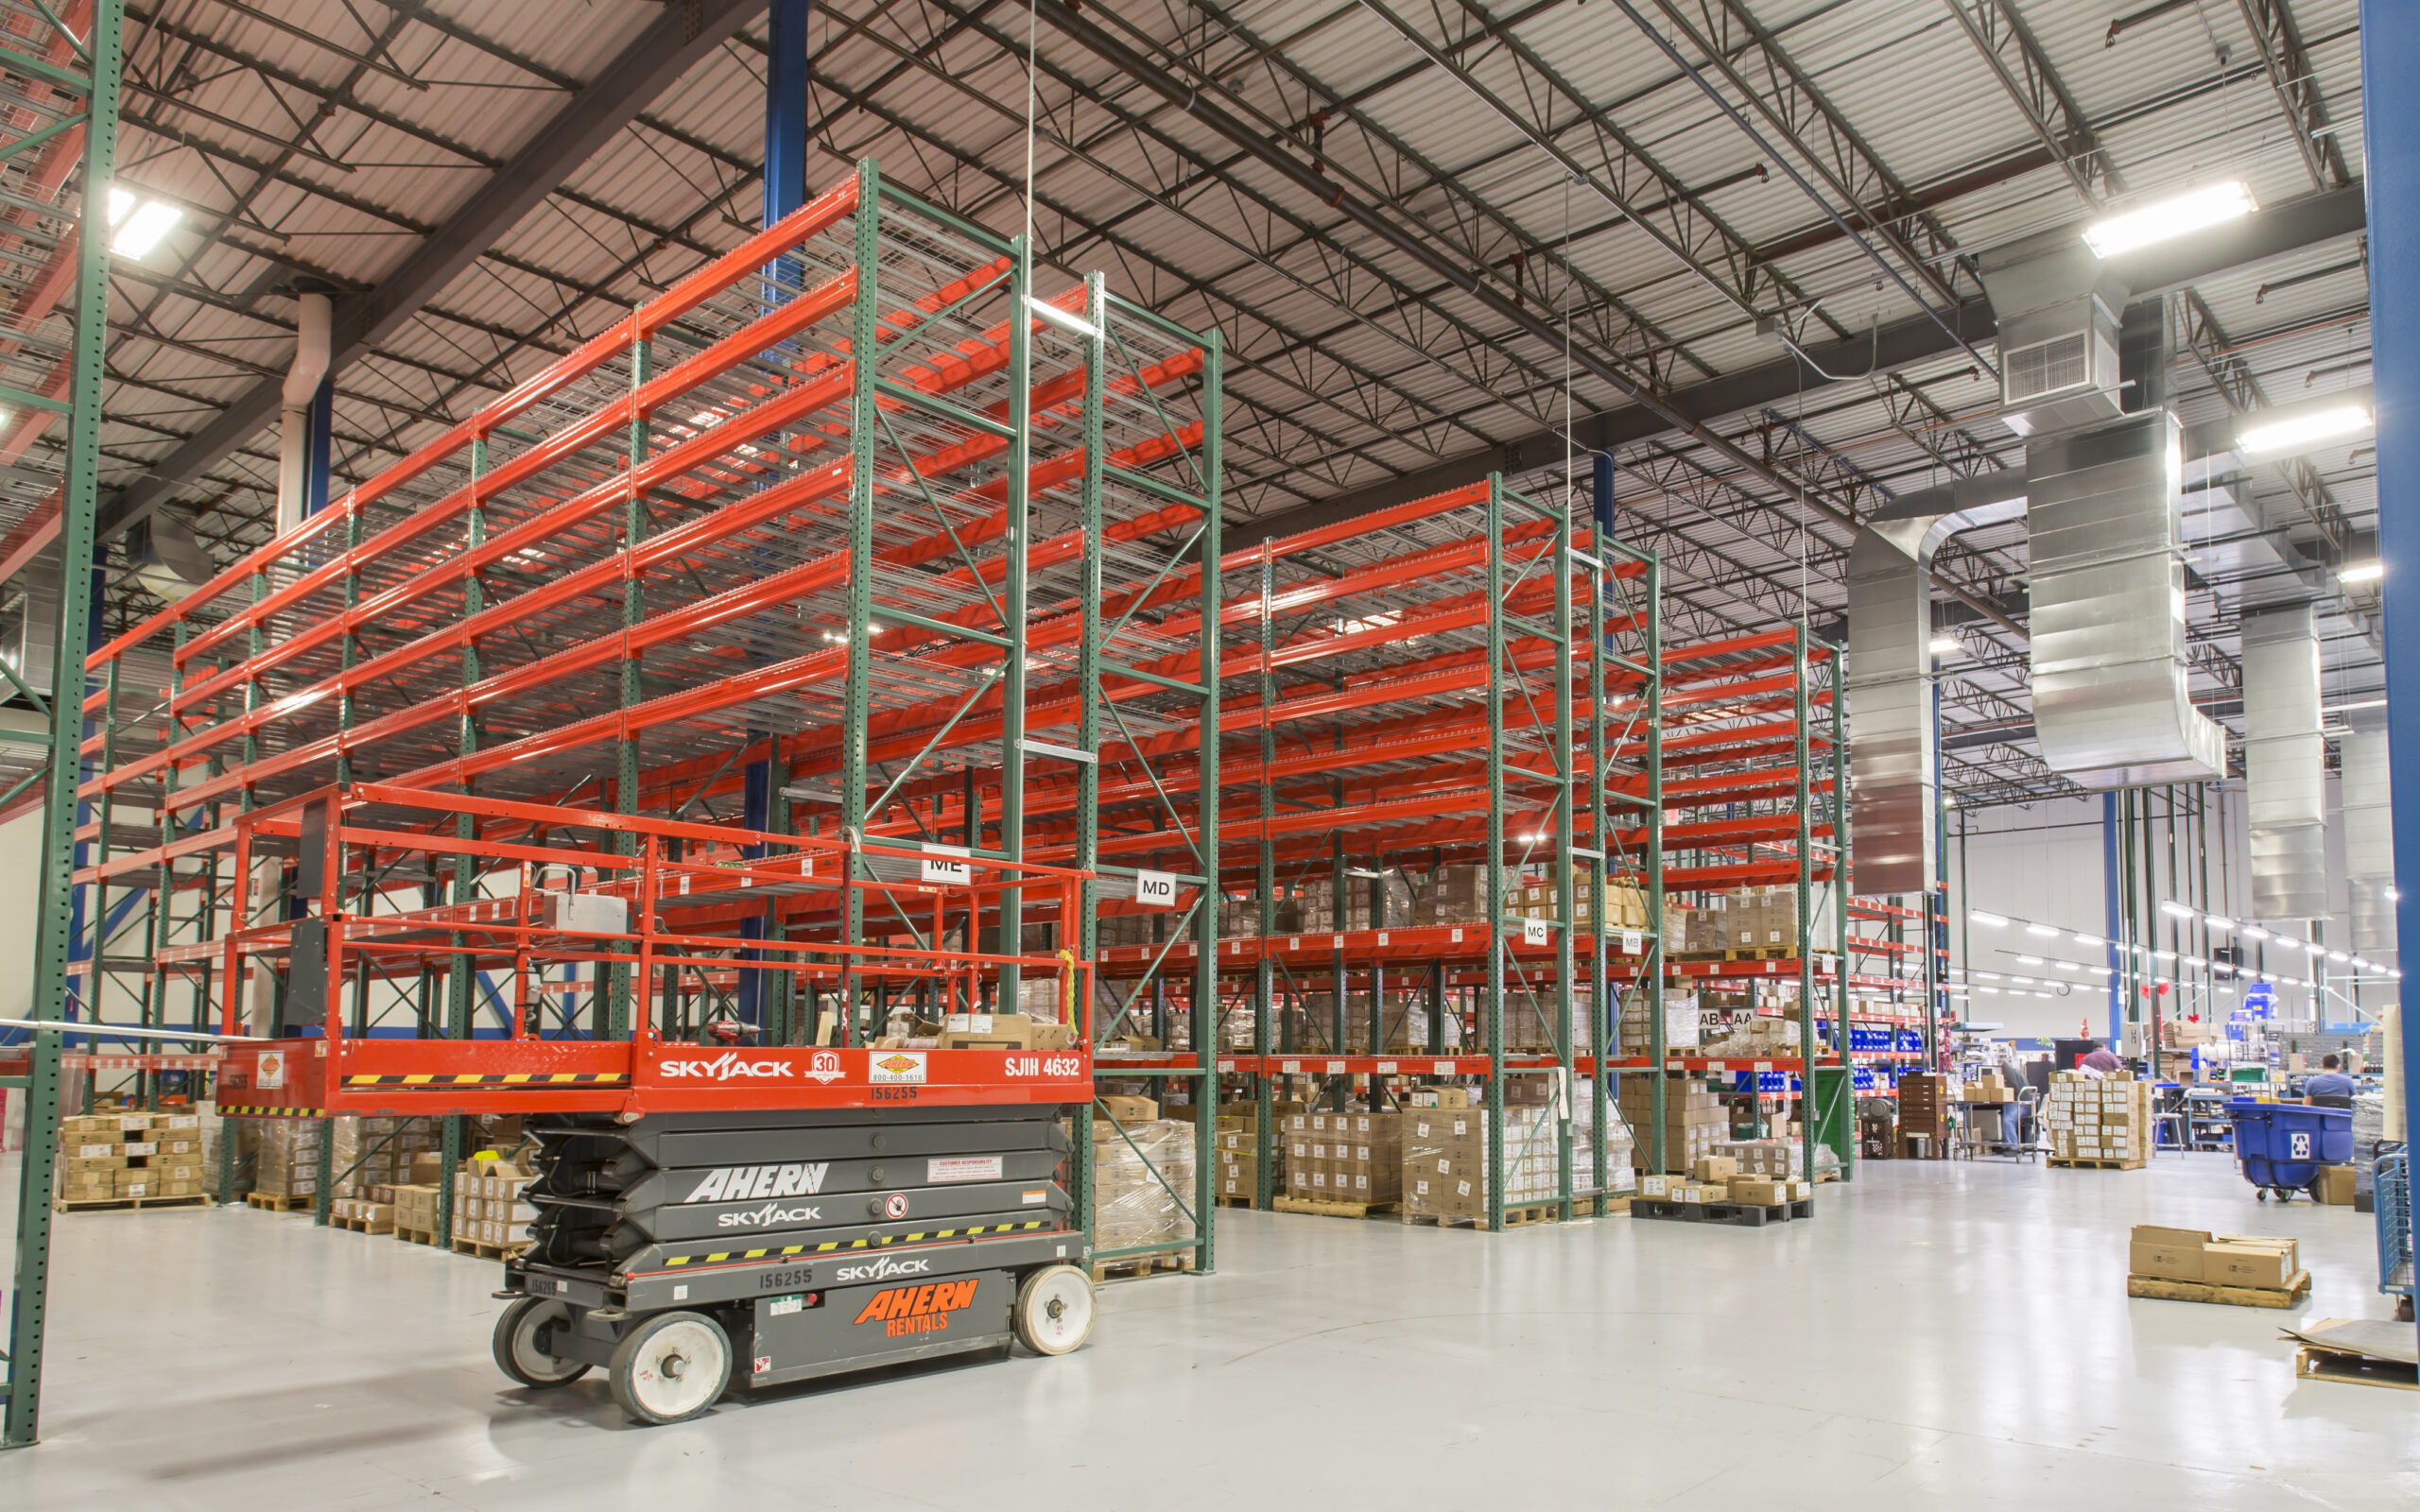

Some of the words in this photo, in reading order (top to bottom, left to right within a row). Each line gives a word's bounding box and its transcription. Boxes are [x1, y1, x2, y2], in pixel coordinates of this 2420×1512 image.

[930, 860, 962, 872] ME
[1143, 880, 1169, 895] MD
[1528, 927, 1544, 937] MC
[1626, 937, 1639, 948] MB
[1700, 1013, 1719, 1025] AB
[1734, 1013, 1752, 1025] AA
[660, 1052, 794, 1081] SKYJACK
[816, 1056, 835, 1072] 30
[1005, 1057, 1039, 1076] SJIH
[1043, 1057, 1080, 1076] 4632
[871, 1087, 918, 1100] 156255
[683, 1162, 829, 1203] AHERN
[718, 1202, 821, 1227] SKYJACK
[837, 1256, 929, 1281] SKYJACK
[760, 1269, 812, 1289] 156255
[853, 1278, 979, 1325] AHERN
[887, 1312, 948, 1338] RENTALS
